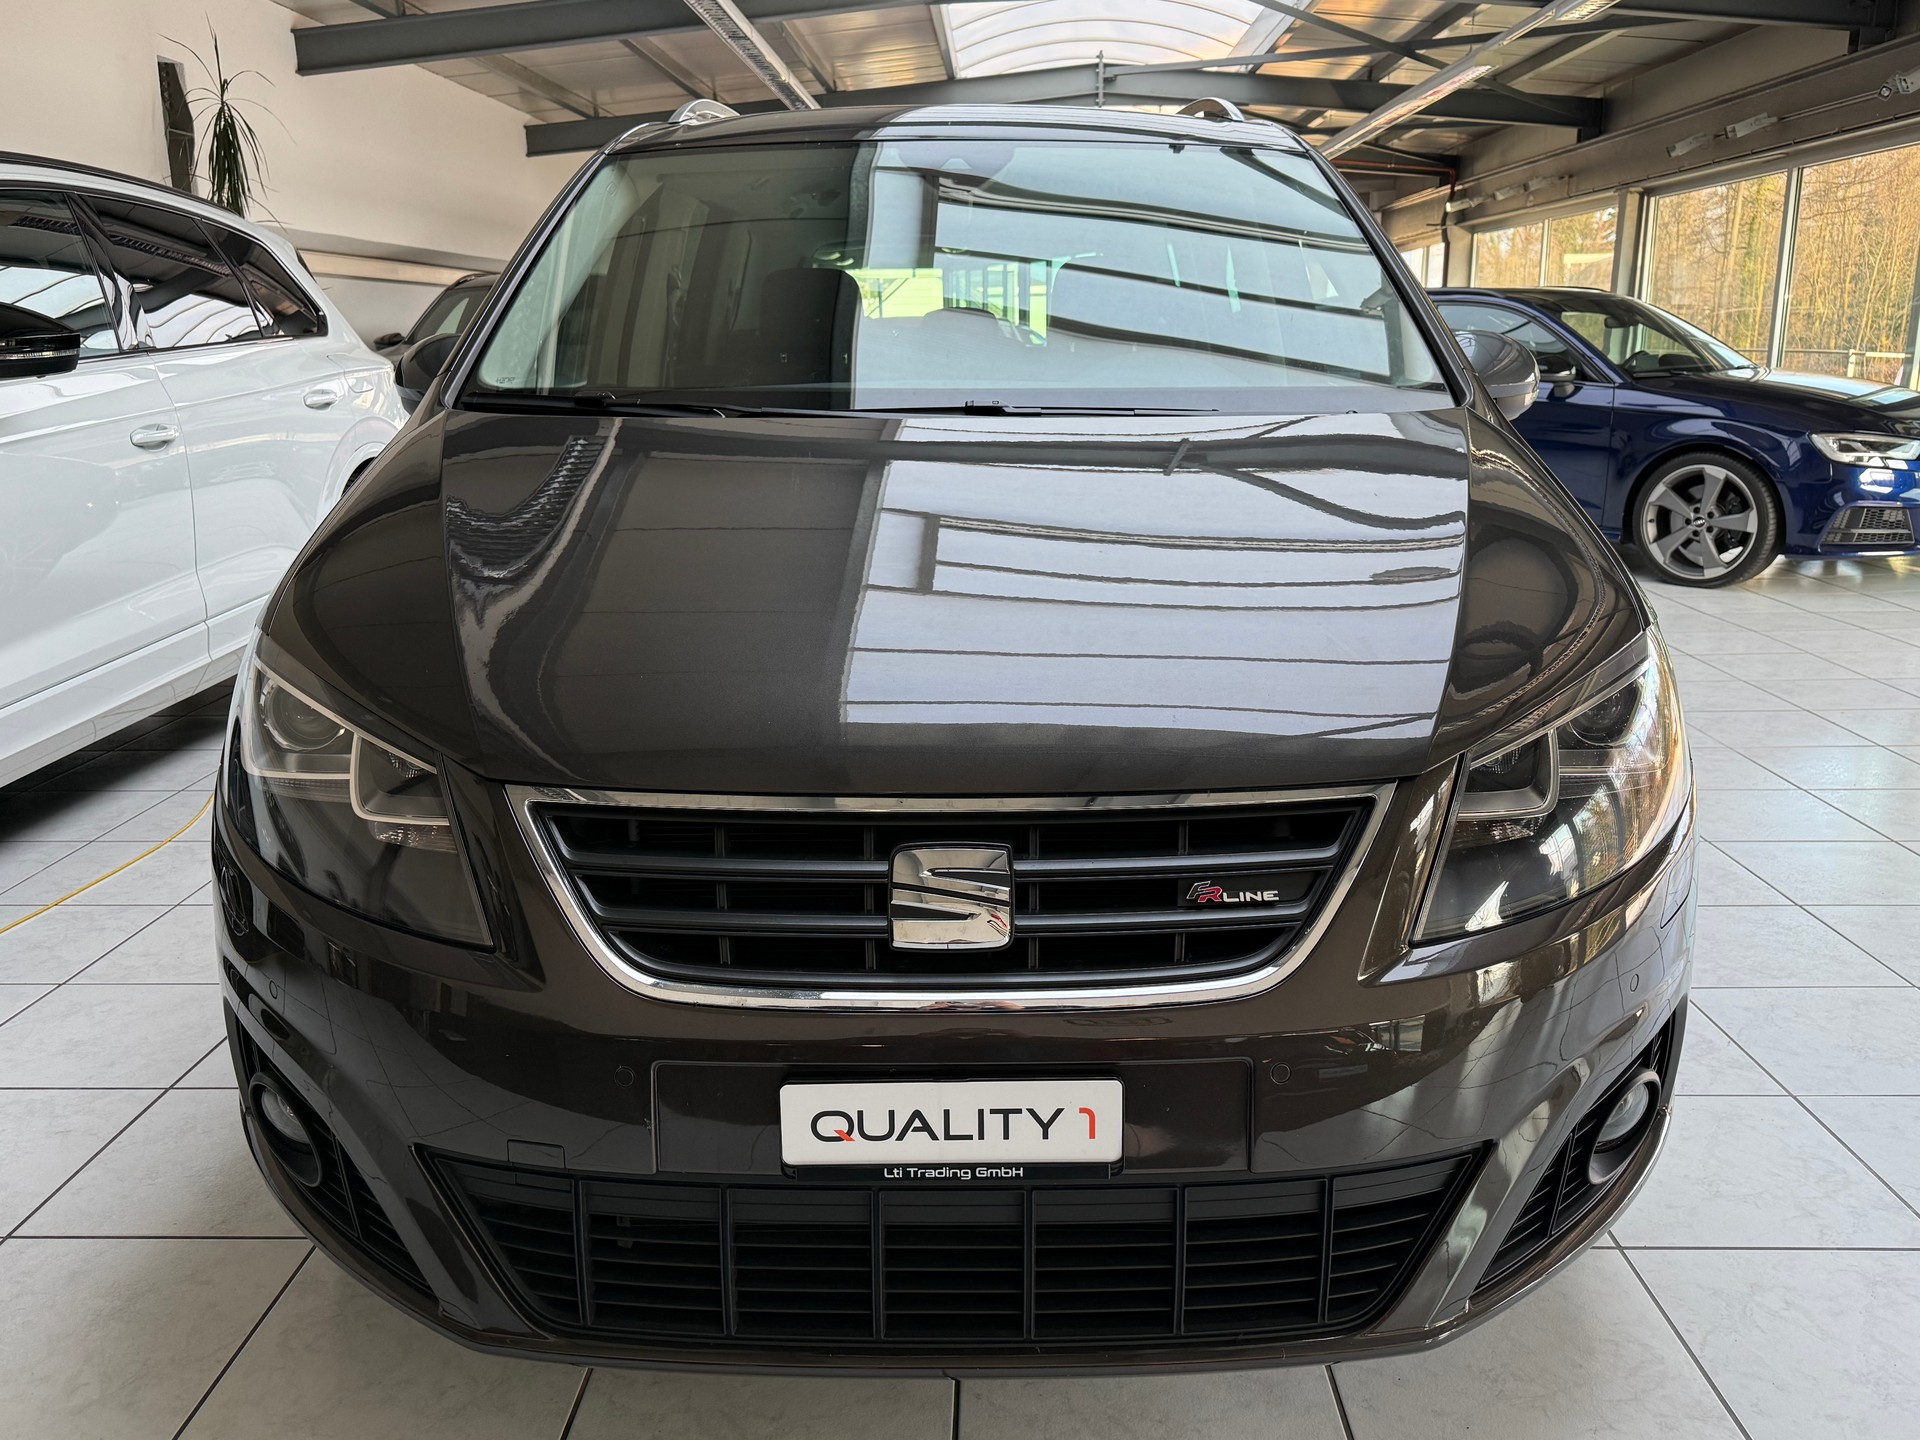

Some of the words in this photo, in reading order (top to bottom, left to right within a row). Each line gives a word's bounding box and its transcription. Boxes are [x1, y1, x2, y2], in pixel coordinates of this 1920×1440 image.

[810, 1107, 1065, 1143] QUALITY
[1078, 1107, 1096, 1140] 1
[883, 1166, 904, 1179] Lti
[906, 1166, 972, 1181] Trading
[975, 1166, 1024, 1179] GmbH
